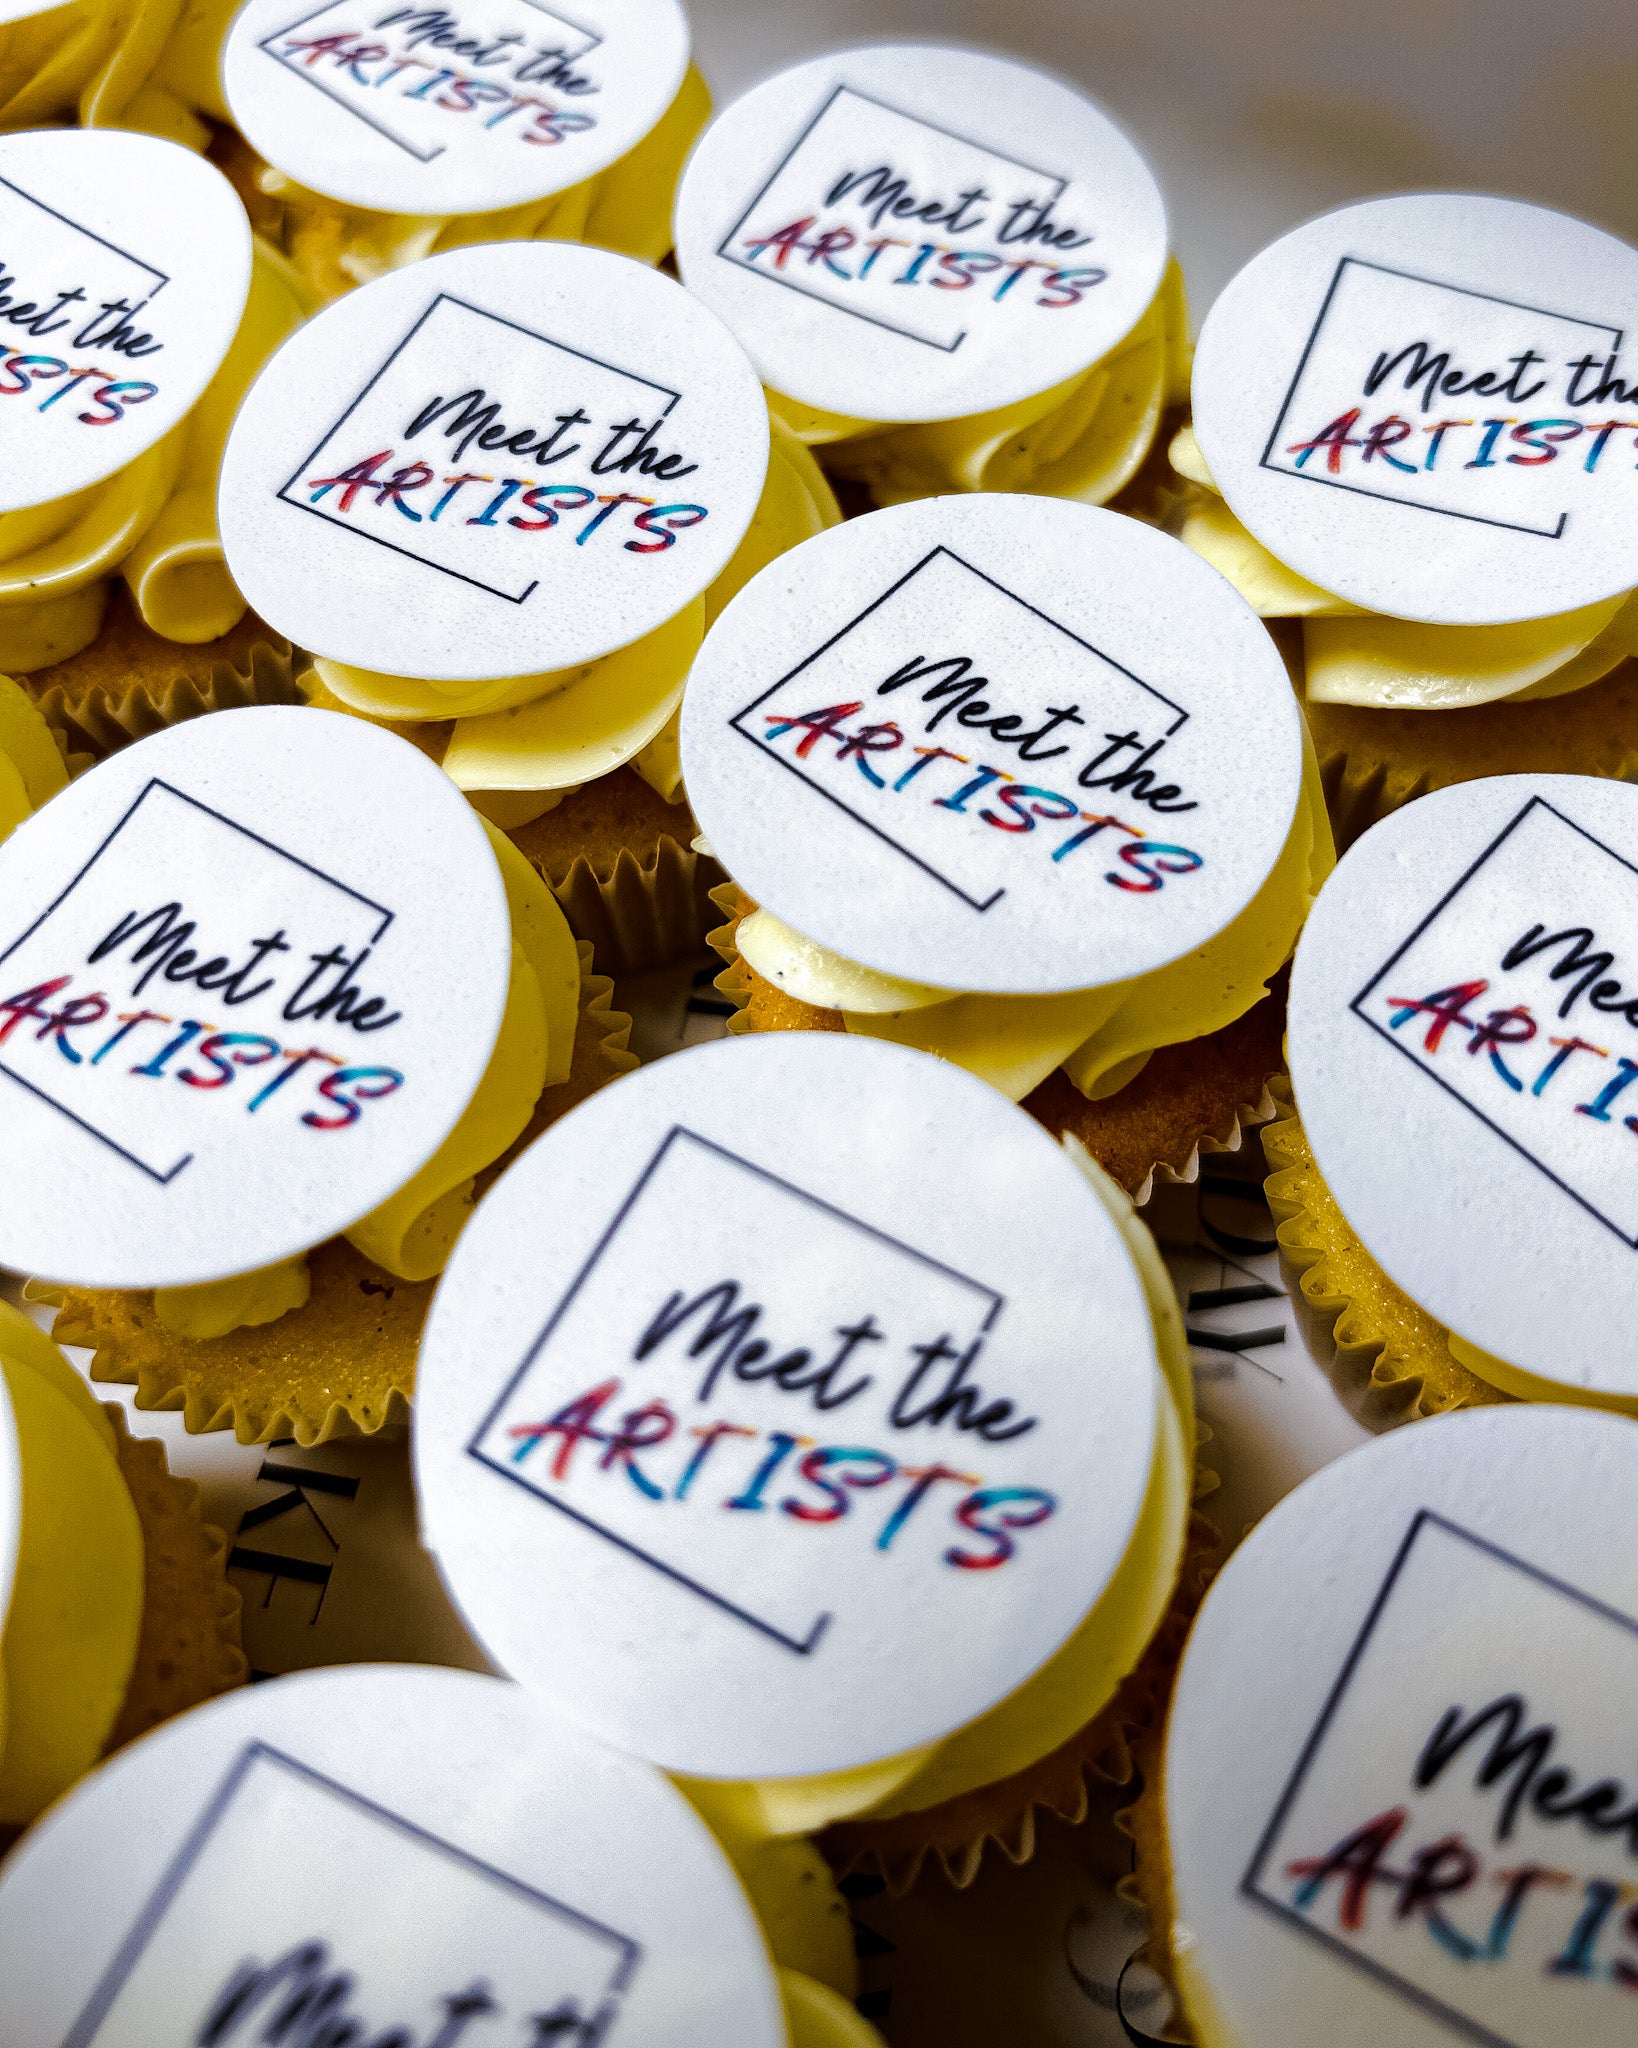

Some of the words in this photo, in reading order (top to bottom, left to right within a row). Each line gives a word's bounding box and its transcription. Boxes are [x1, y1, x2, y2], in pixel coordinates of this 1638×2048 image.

[283, 33, 597, 145] ARTISTS
[375, 4, 512, 67] Meet
[515, 47, 598, 97] the
[743, 216, 1108, 308] ARTISTS
[828, 165, 992, 237] Meet
[998, 196, 1092, 251] the
[73, 298, 164, 357] the
[1363, 340, 1548, 411] Meet
[1565, 354, 1638, 407] th
[404, 388, 591, 467] Meet
[591, 409, 698, 482] the
[1288, 407, 1638, 476] ARTIST
[309, 449, 709, 554] ARTISTS
[876, 655, 1086, 762] Meet
[1077, 728, 1198, 814] the
[765, 700, 1204, 894] ARTISTS
[88, 902, 291, 1003] Meet
[282, 944, 403, 1032] the
[1386, 978, 1638, 1136] ARTI
[633, 1279, 885, 1412] Meet
[889, 1332, 1040, 1446] the
[508, 1378, 1058, 1571] ARTISTS
[1411, 1692, 1638, 1860] Mee
